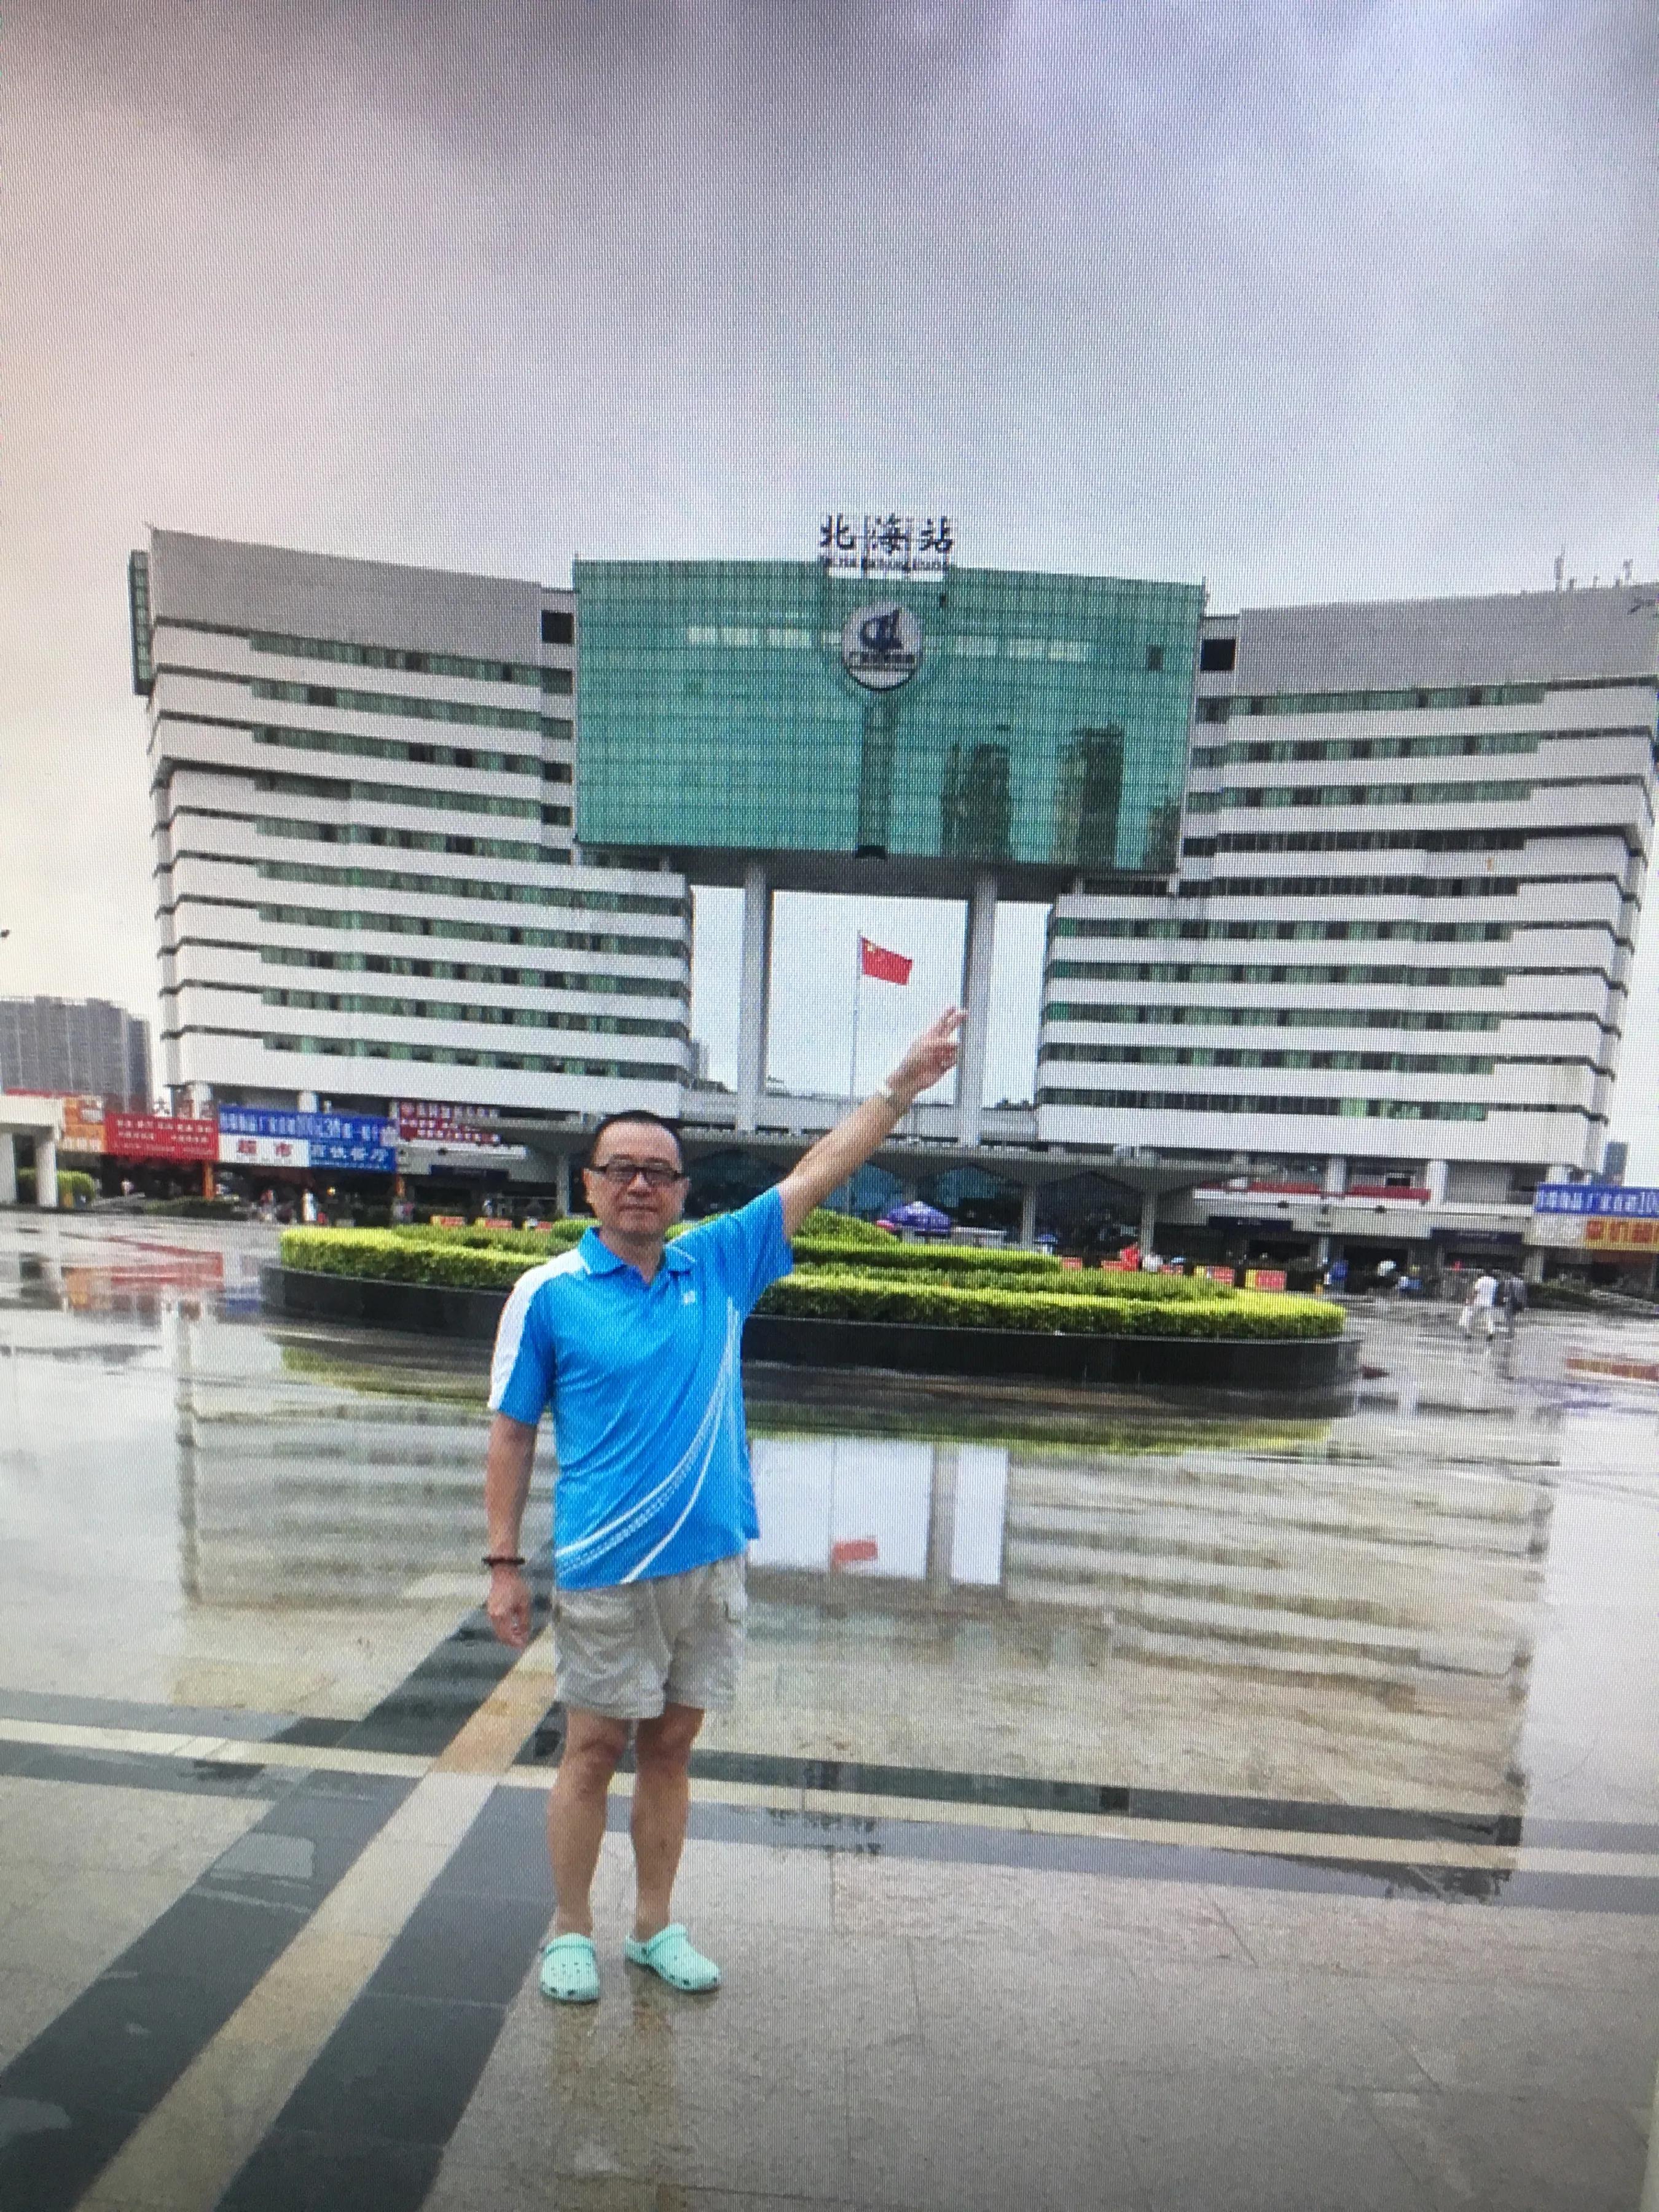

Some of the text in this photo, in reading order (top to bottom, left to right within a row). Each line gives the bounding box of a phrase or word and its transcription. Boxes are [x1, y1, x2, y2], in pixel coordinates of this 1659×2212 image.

[820, 513, 954, 555] 北海站
[237, 1138, 293, 1158] 超市
